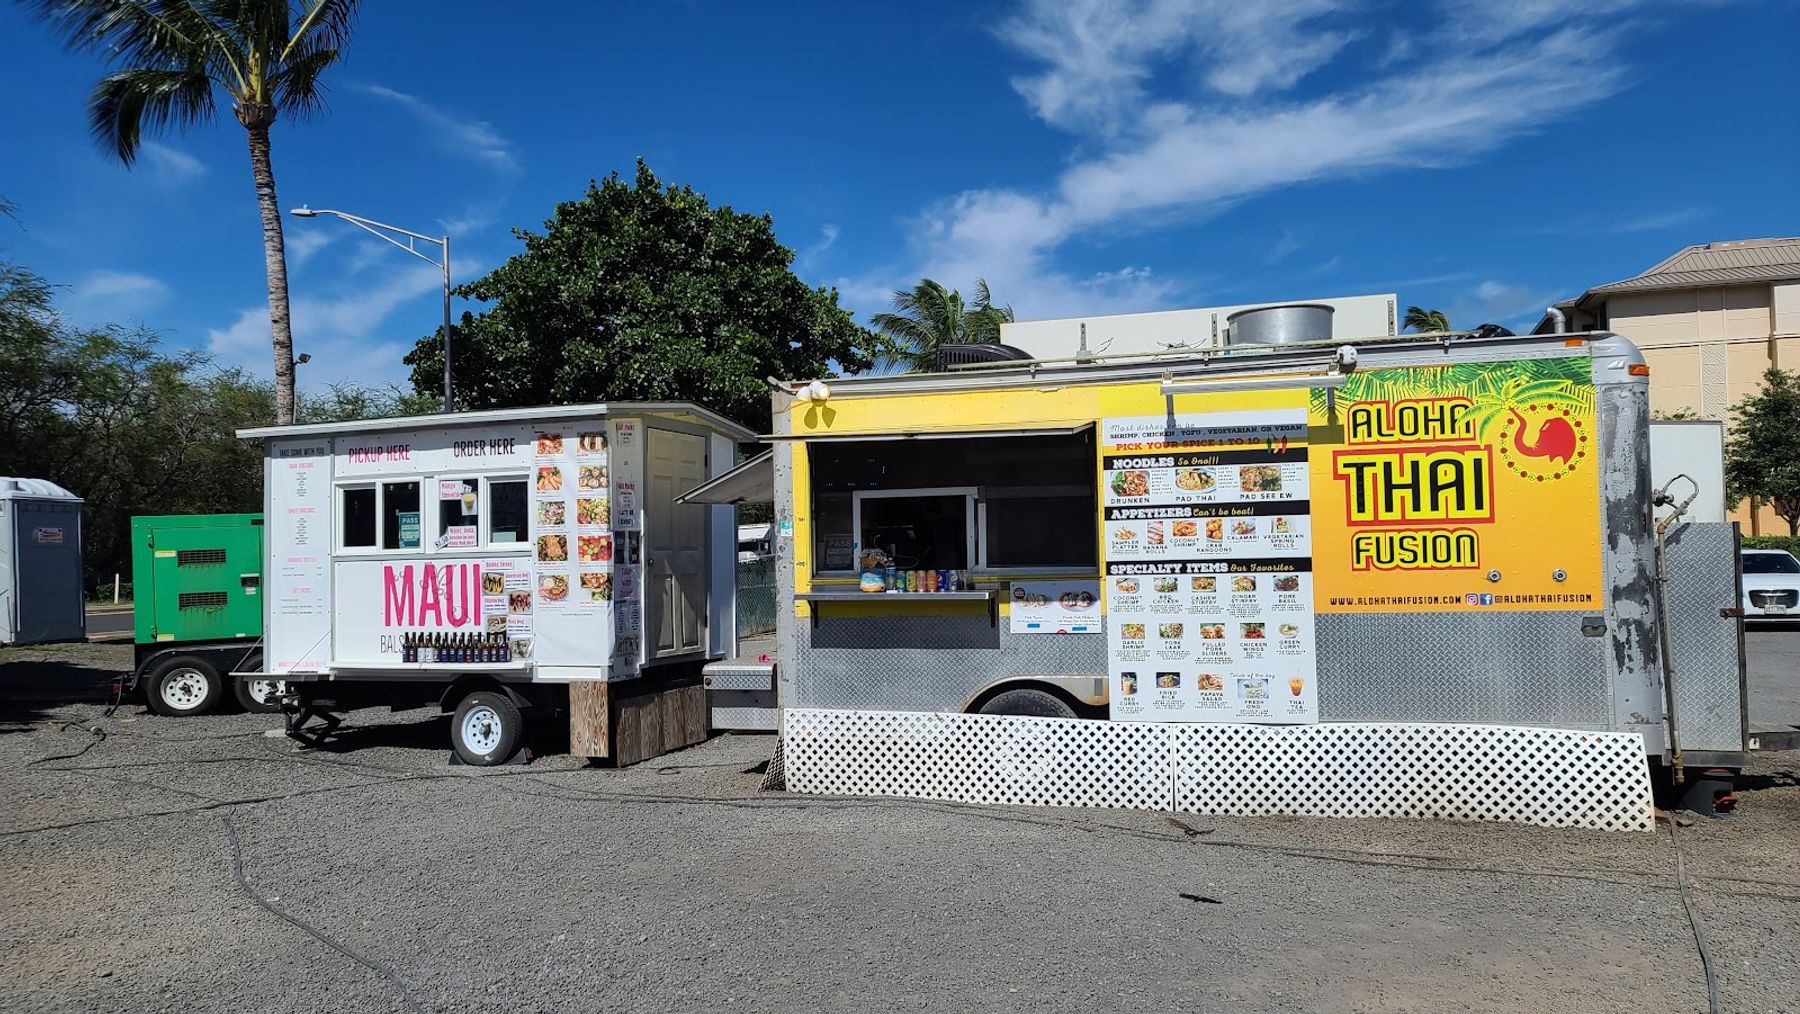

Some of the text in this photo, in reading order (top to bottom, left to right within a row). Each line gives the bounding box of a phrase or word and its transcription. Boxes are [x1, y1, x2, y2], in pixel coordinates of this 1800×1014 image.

[1110, 424, 1134, 433] Most
[1136, 423, 1164, 432] dishes
[1350, 402, 1473, 440] ALOHA
[453, 438, 515, 458] ORDER HERE
[1116, 443, 1143, 451] PICK
[1146, 440, 1178, 449] YOUR
[1182, 439, 1217, 447] SPICE
[1247, 437, 1260, 445] 10
[348, 444, 410, 464] PICKUP HERE
[1112, 457, 1175, 470] NOODLES
[1178, 457, 1189, 466] So
[1341, 455, 1486, 516] THAI
[1111, 507, 1254, 519] APPETIZERS Can't be beat!
[1354, 531, 1477, 567] FUSION
[1110, 562, 1295, 575] SPECIALTY ITEMS Our Favorites
[383, 563, 482, 628] MAUI
[1330, 594, 1592, 605] WWW.ALOHATHAIFUSION.COM @ALOHATHAIFUSION
